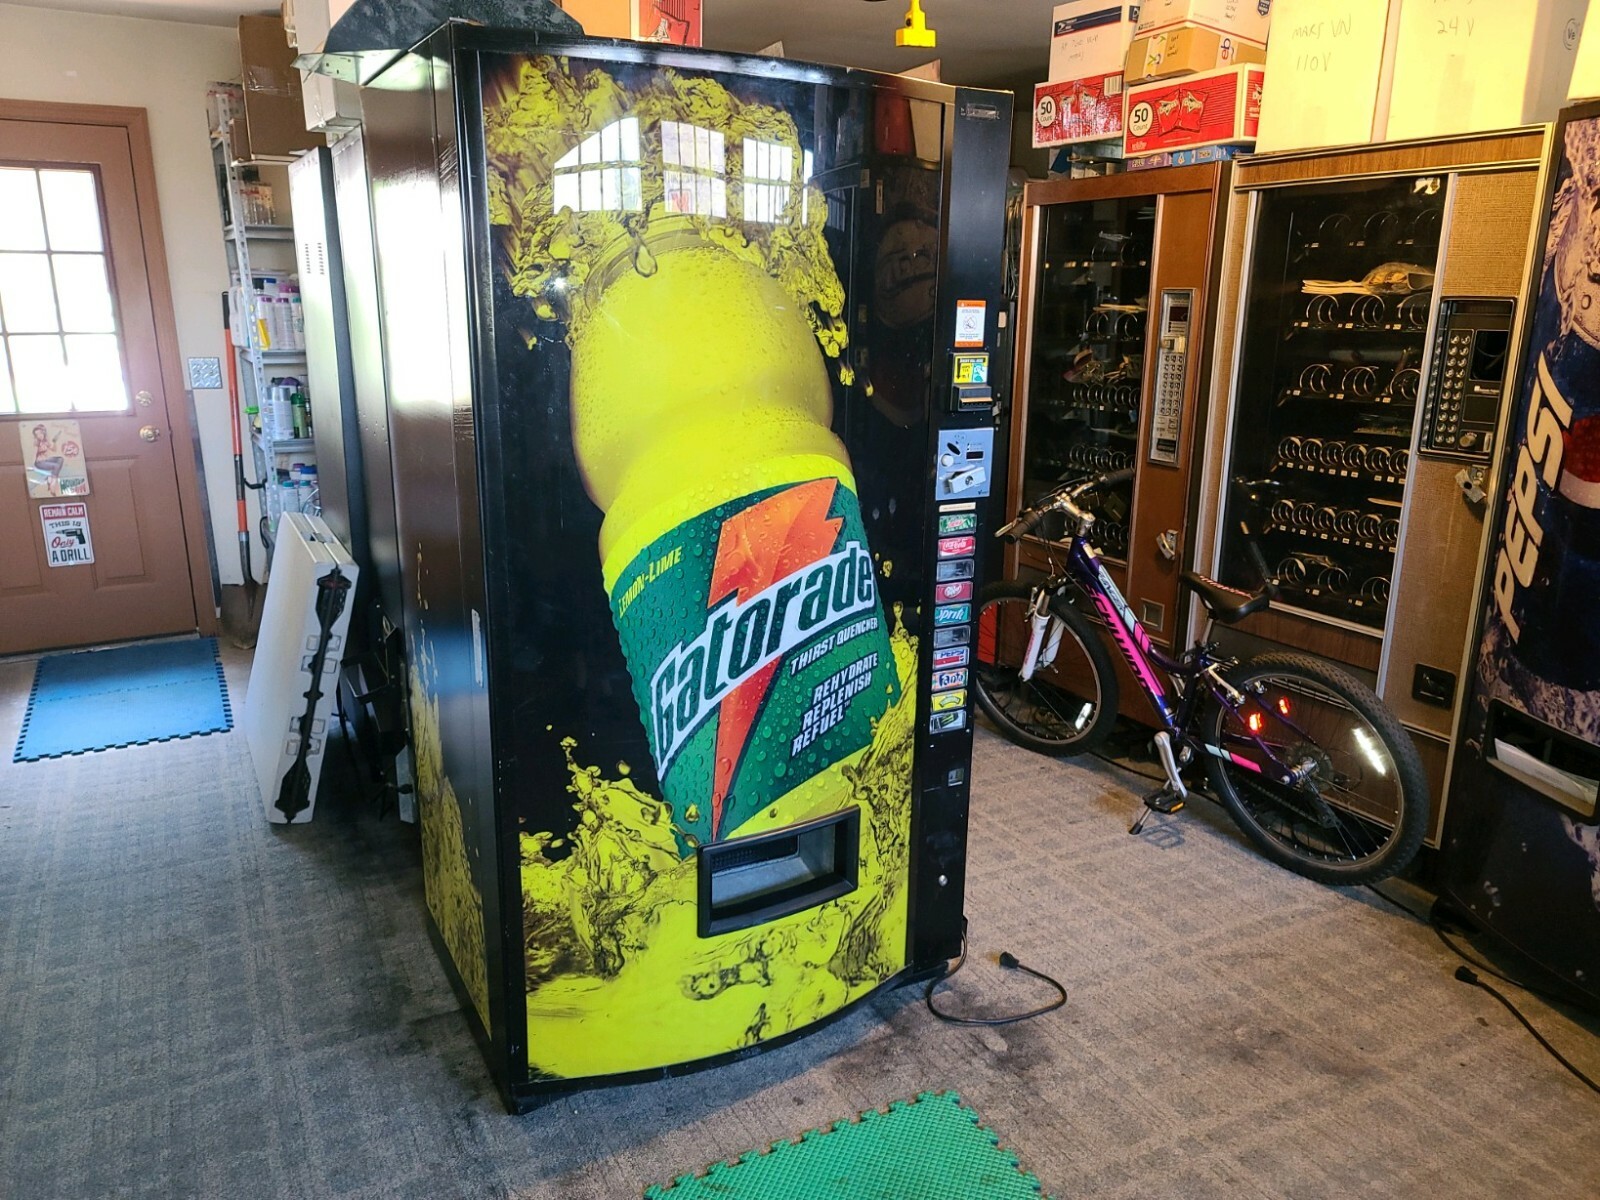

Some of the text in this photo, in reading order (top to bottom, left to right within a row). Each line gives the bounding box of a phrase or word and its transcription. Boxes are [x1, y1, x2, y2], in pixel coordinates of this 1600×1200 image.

[1040, 100, 1053, 115] 50
[1133, 107, 1149, 123] 50
[1133, 123, 1149, 131] Count
[1494, 351, 1574, 645] PEPSI
[44, 505, 84, 518] REMAIN CALM
[49, 520, 70, 529] THIS
[52, 536, 75, 549] Only
[52, 548, 91, 563] A DRILL
[618, 546, 682, 619] LEMON-LIME
[791, 617, 878, 676] THIRST QUENCHER
[651, 541, 875, 781] Gatorade
[813, 653, 878, 704] REHYDRATE
[803, 672, 872, 729] REPLENISH
